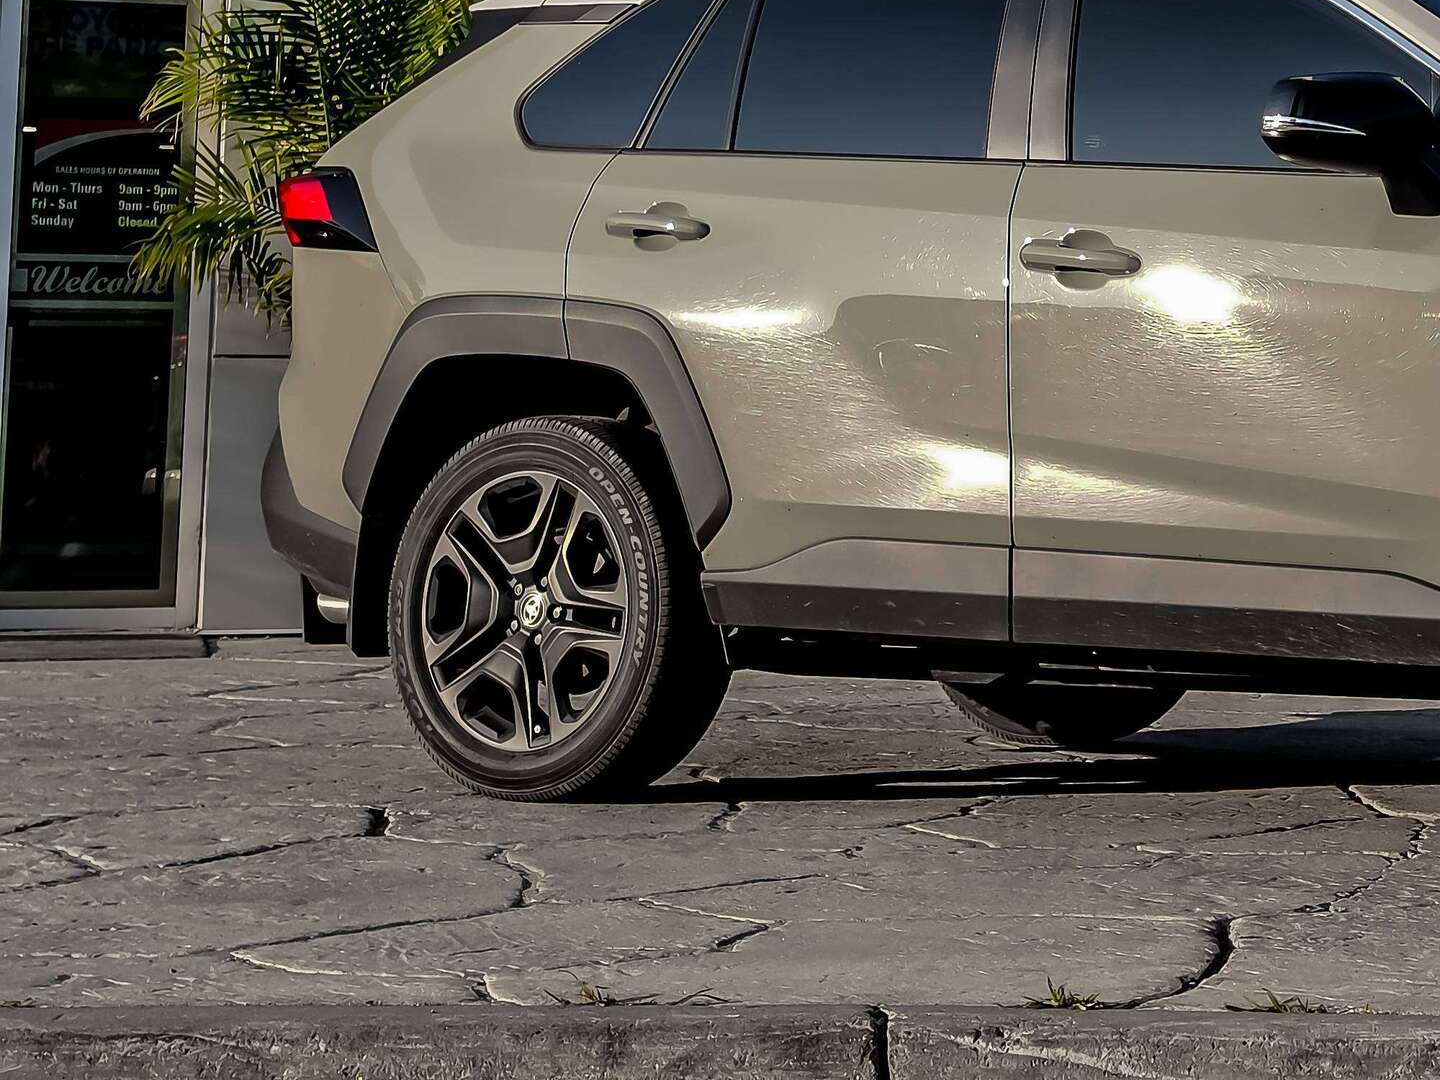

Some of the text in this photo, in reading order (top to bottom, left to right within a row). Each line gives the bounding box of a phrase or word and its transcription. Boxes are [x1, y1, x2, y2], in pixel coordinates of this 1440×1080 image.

[118, 167, 160, 176] OPERATION
[32, 181, 59, 193] Mon
[69, 182, 103, 194] Thurs
[119, 183, 143, 195] 9am
[153, 184, 178, 198] 9pm
[31, 197, 47, 209] Fri
[58, 198, 78, 210] Sat
[118, 200, 142, 211] 9am
[31, 214, 74, 229] Sunday
